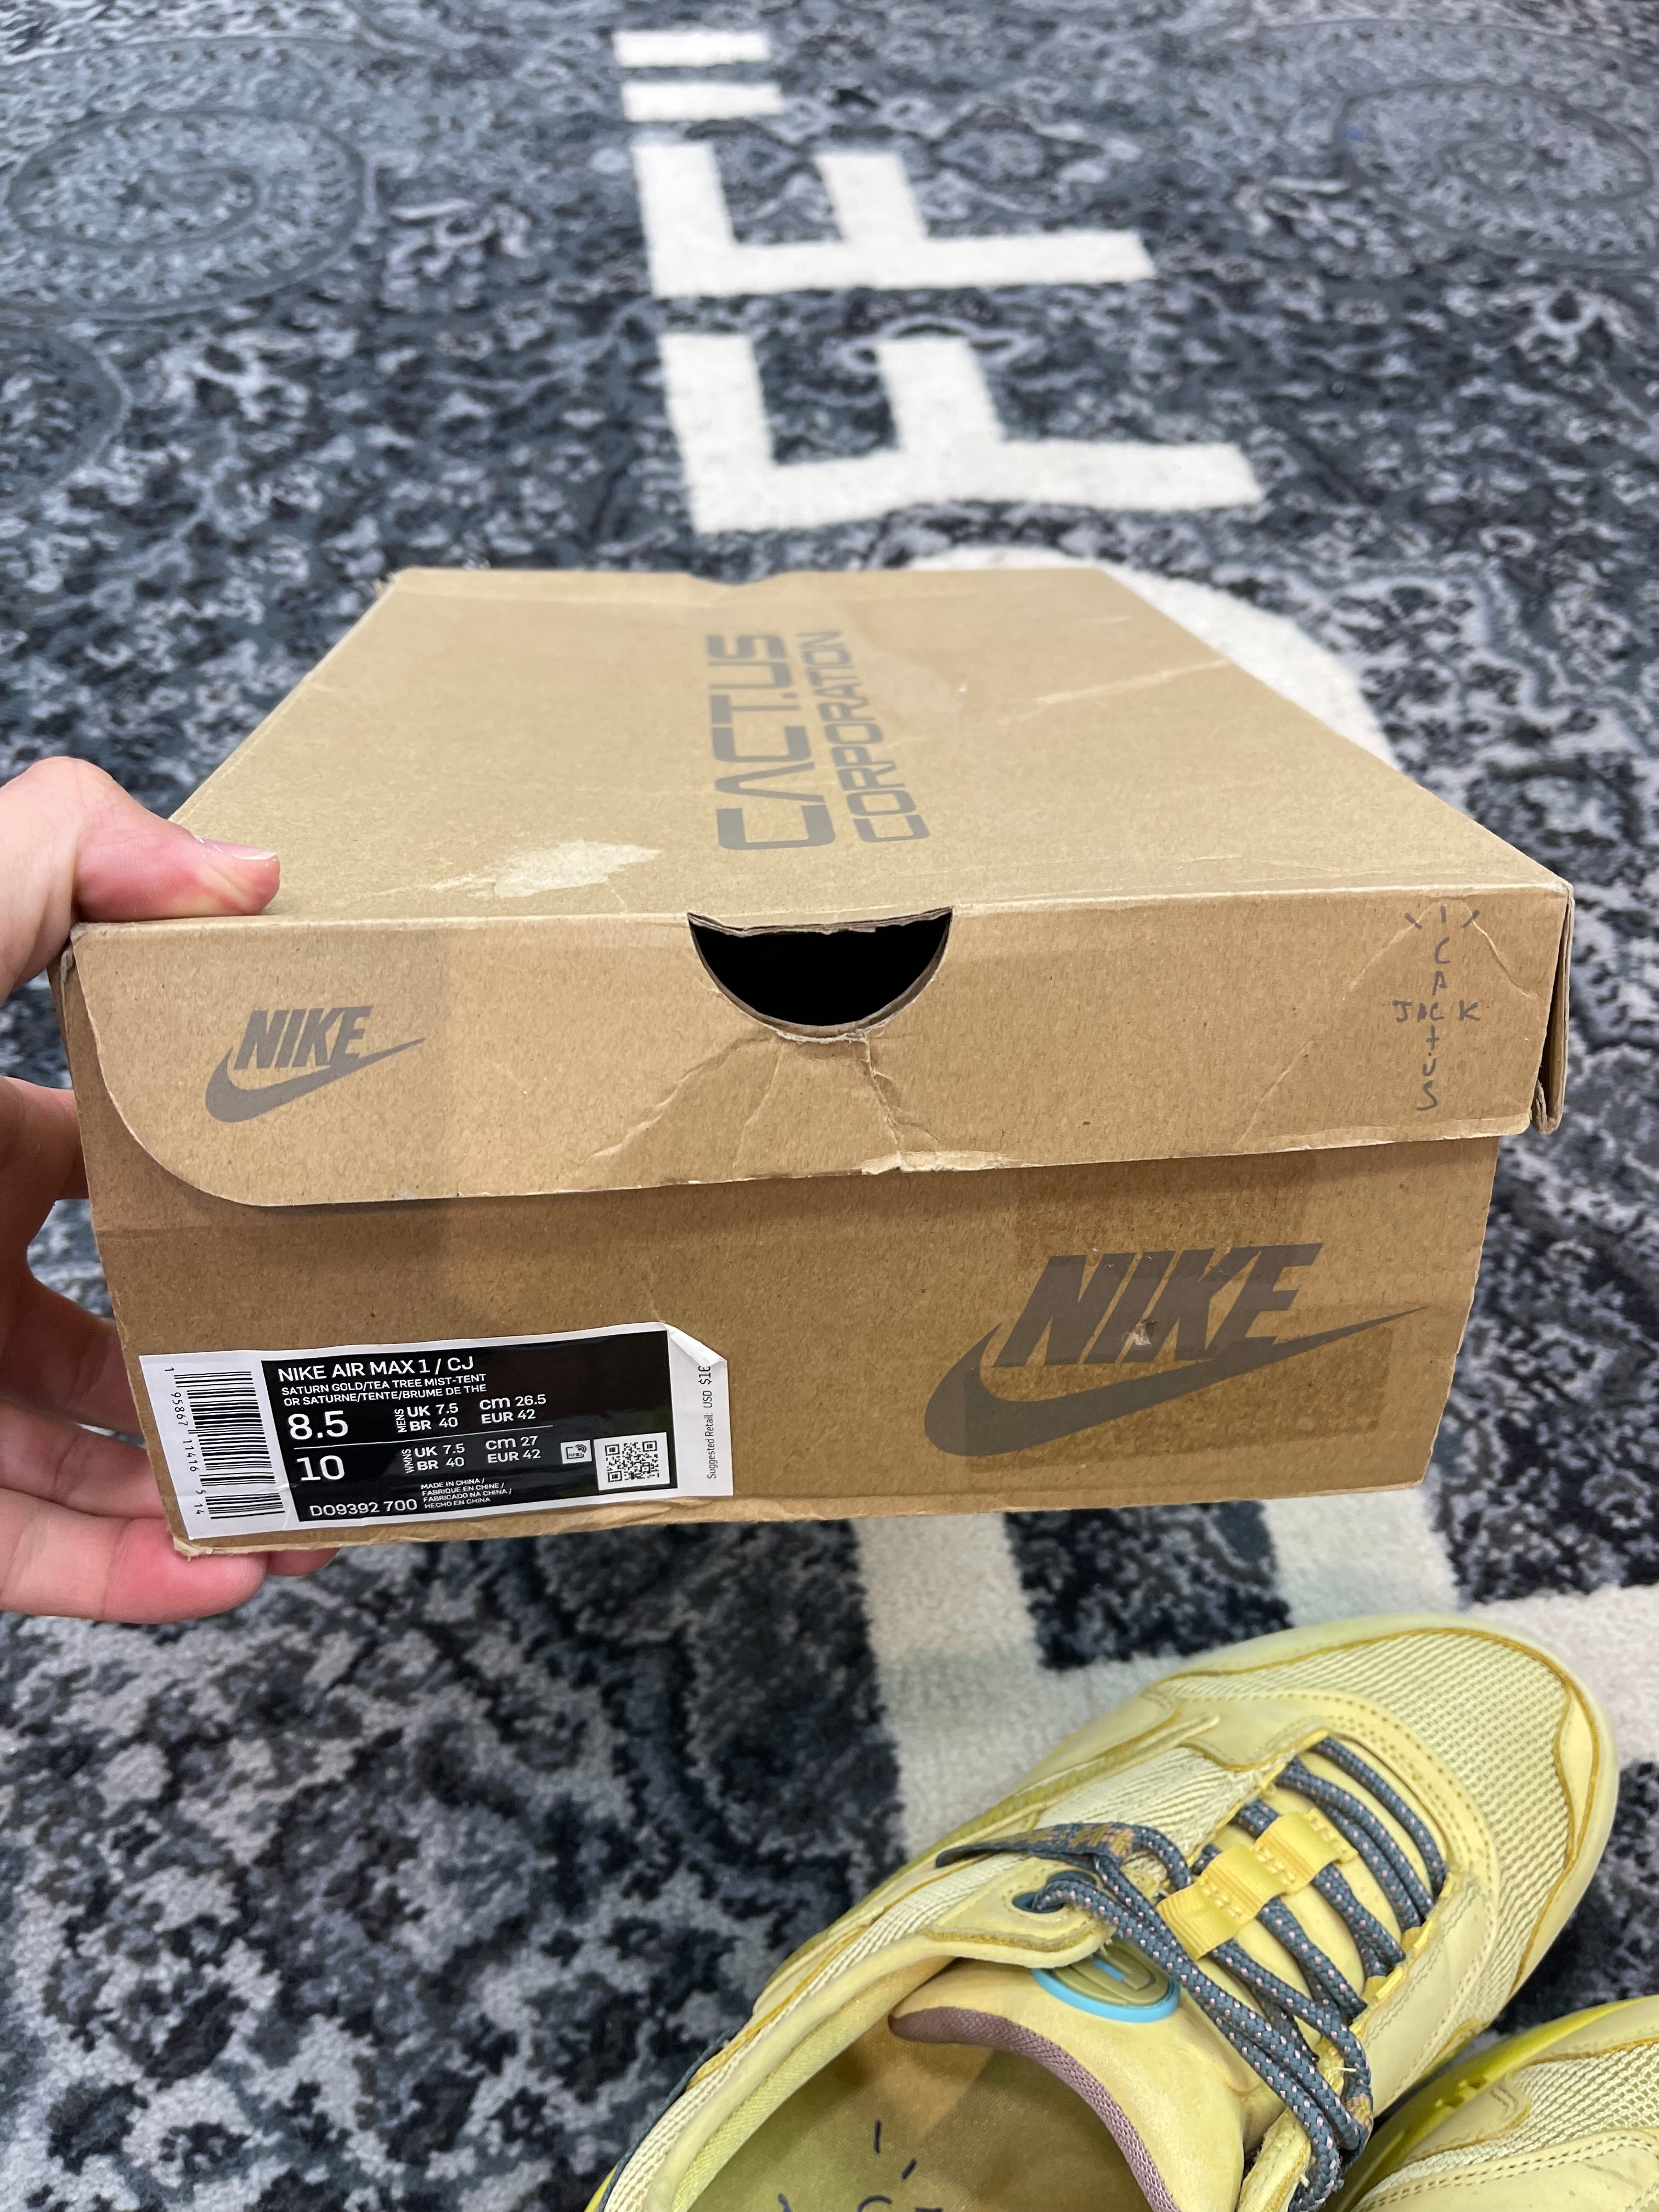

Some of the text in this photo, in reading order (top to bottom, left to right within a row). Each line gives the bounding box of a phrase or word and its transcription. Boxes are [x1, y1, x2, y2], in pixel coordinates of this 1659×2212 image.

[795, 630, 930, 843] CORPORATION
[234, 1005, 373, 1070] NIKE
[992, 1242, 1323, 1367] NIKE
[278, 1365, 326, 1383] NIKE
[331, 1362, 364, 1378] AIR
[370, 1359, 415, 1376] MAX
[419, 1359, 431, 1374] 1
[447, 1356, 473, 1372] CJ
[281, 1374, 487, 1396] SATURN GOLD/TEA TREE MIST-TENT
[284, 1384, 488, 1407] OR SATURNE/TENTE/BRUME DE THE
[479, 1394, 546, 1410] cm 26.5
[702, 1390, 713, 1408] USD
[171, 1392, 189, 1426] 95867
[407, 1403, 459, 1417] UK 7.5
[481, 1409, 536, 1424] EUR 42
[287, 1410, 348, 1441] 8.5
[394, 1408, 407, 1433] MENS
[409, 1417, 458, 1432] BR 40
[414, 1443, 465, 1458] UK 7.5
[486, 1435, 538, 1451] cm 27
[183, 1438, 200, 1472] 11416
[403, 1449, 415, 1474] WMNS
[416, 1457, 465, 1471] BR 40
[487, 1449, 541, 1463] EUR 42
[707, 1438, 718, 1479] Suggested
[296, 1455, 345, 1481] 10
[421, 1481, 444, 1489] MADE
[421, 1487, 461, 1496] FABRIQUE
[383, 1498, 417, 1511] 700
[423, 1493, 468, 1503] FABRICADO
